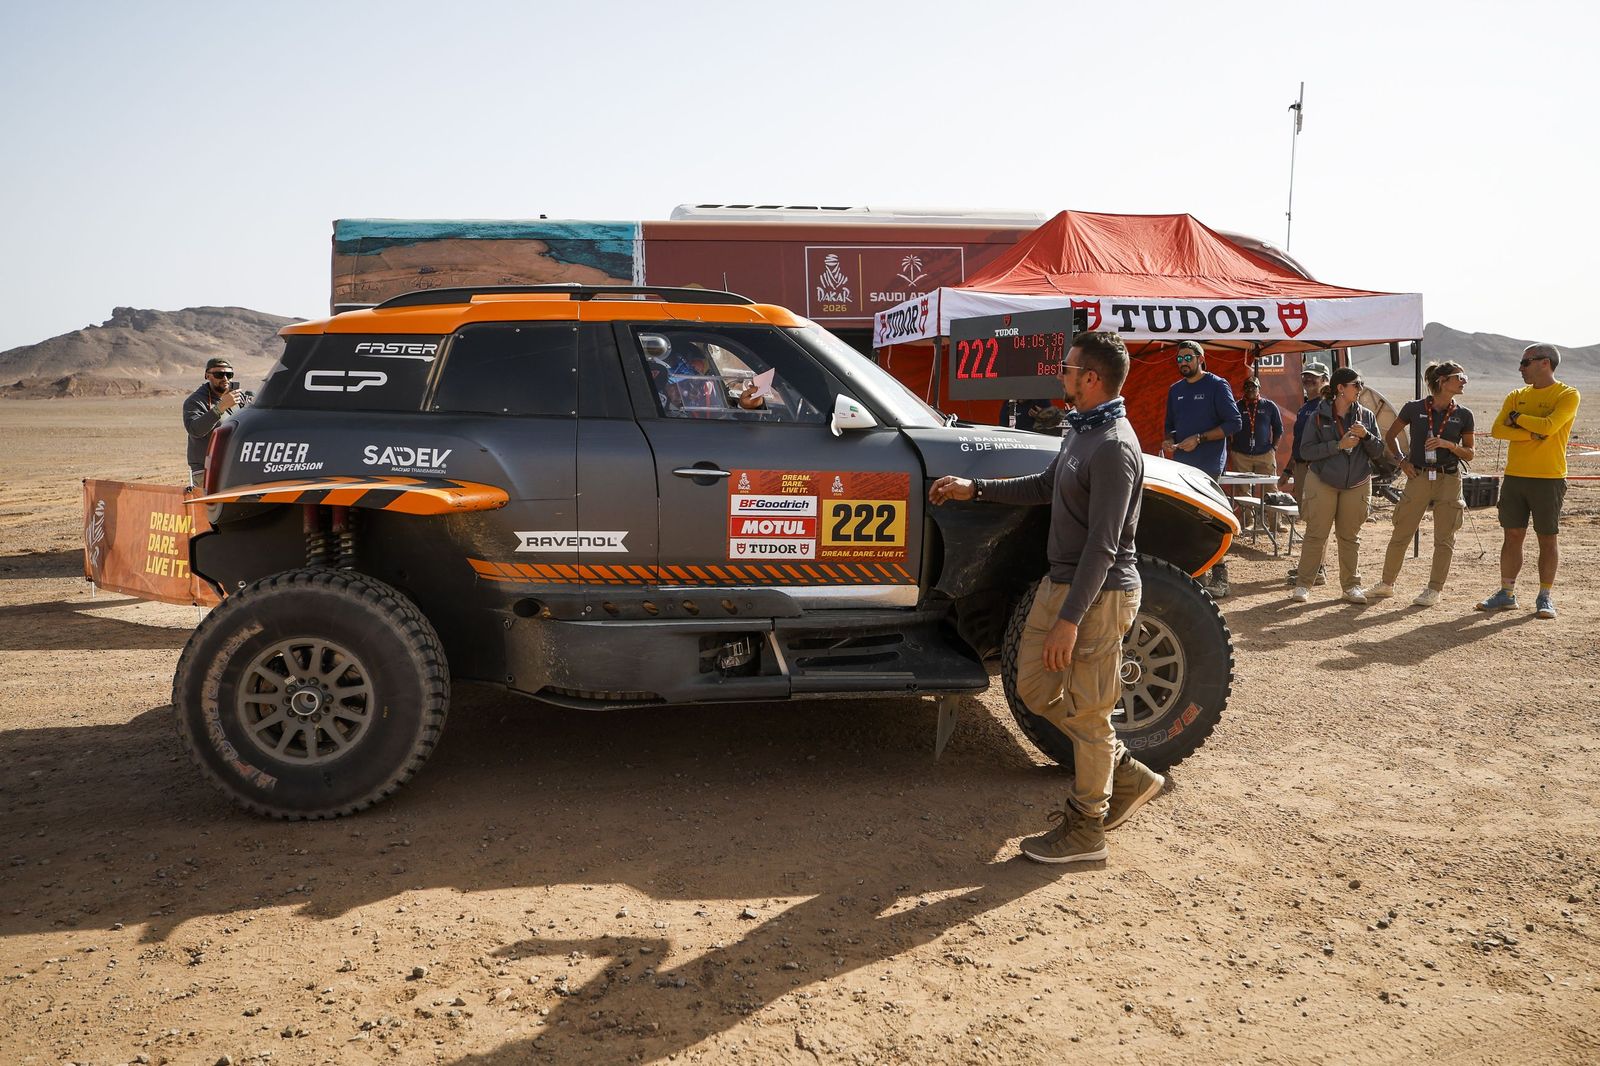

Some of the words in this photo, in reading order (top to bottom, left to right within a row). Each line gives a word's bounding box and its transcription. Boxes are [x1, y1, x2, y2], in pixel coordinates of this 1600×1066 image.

[816, 286, 852, 303] DAKAR
[870, 292, 906, 302] SAUDI
[823, 304, 847, 313] 2026
[886, 305, 919, 339] TUDOR
[1111, 304, 1270, 334] TUDOR
[995, 327, 1019, 337] TUDOR
[1013, 331, 1064, 350] 04:05:36
[354, 342, 438, 355] FASTER
[957, 338, 999, 379] 222
[304, 370, 388, 392] CP
[240, 442, 310, 463] REIGER
[960, 443, 973, 452] G.
[975, 443, 992, 451] DE
[362, 445, 452, 468] SADEV
[739, 499, 809, 509] BFGoodrich
[741, 520, 805, 535] MOTUL
[831, 503, 896, 542] 222
[148, 533, 179, 555] DARE.
[526, 536, 618, 547] RAVENOL
[749, 544, 798, 554] TUDOR
[876, 550, 895, 558] LIVE
[895, 550, 905, 558] IT.
[146, 555, 169, 577] LIVE
[170, 558, 190, 578] IT.
